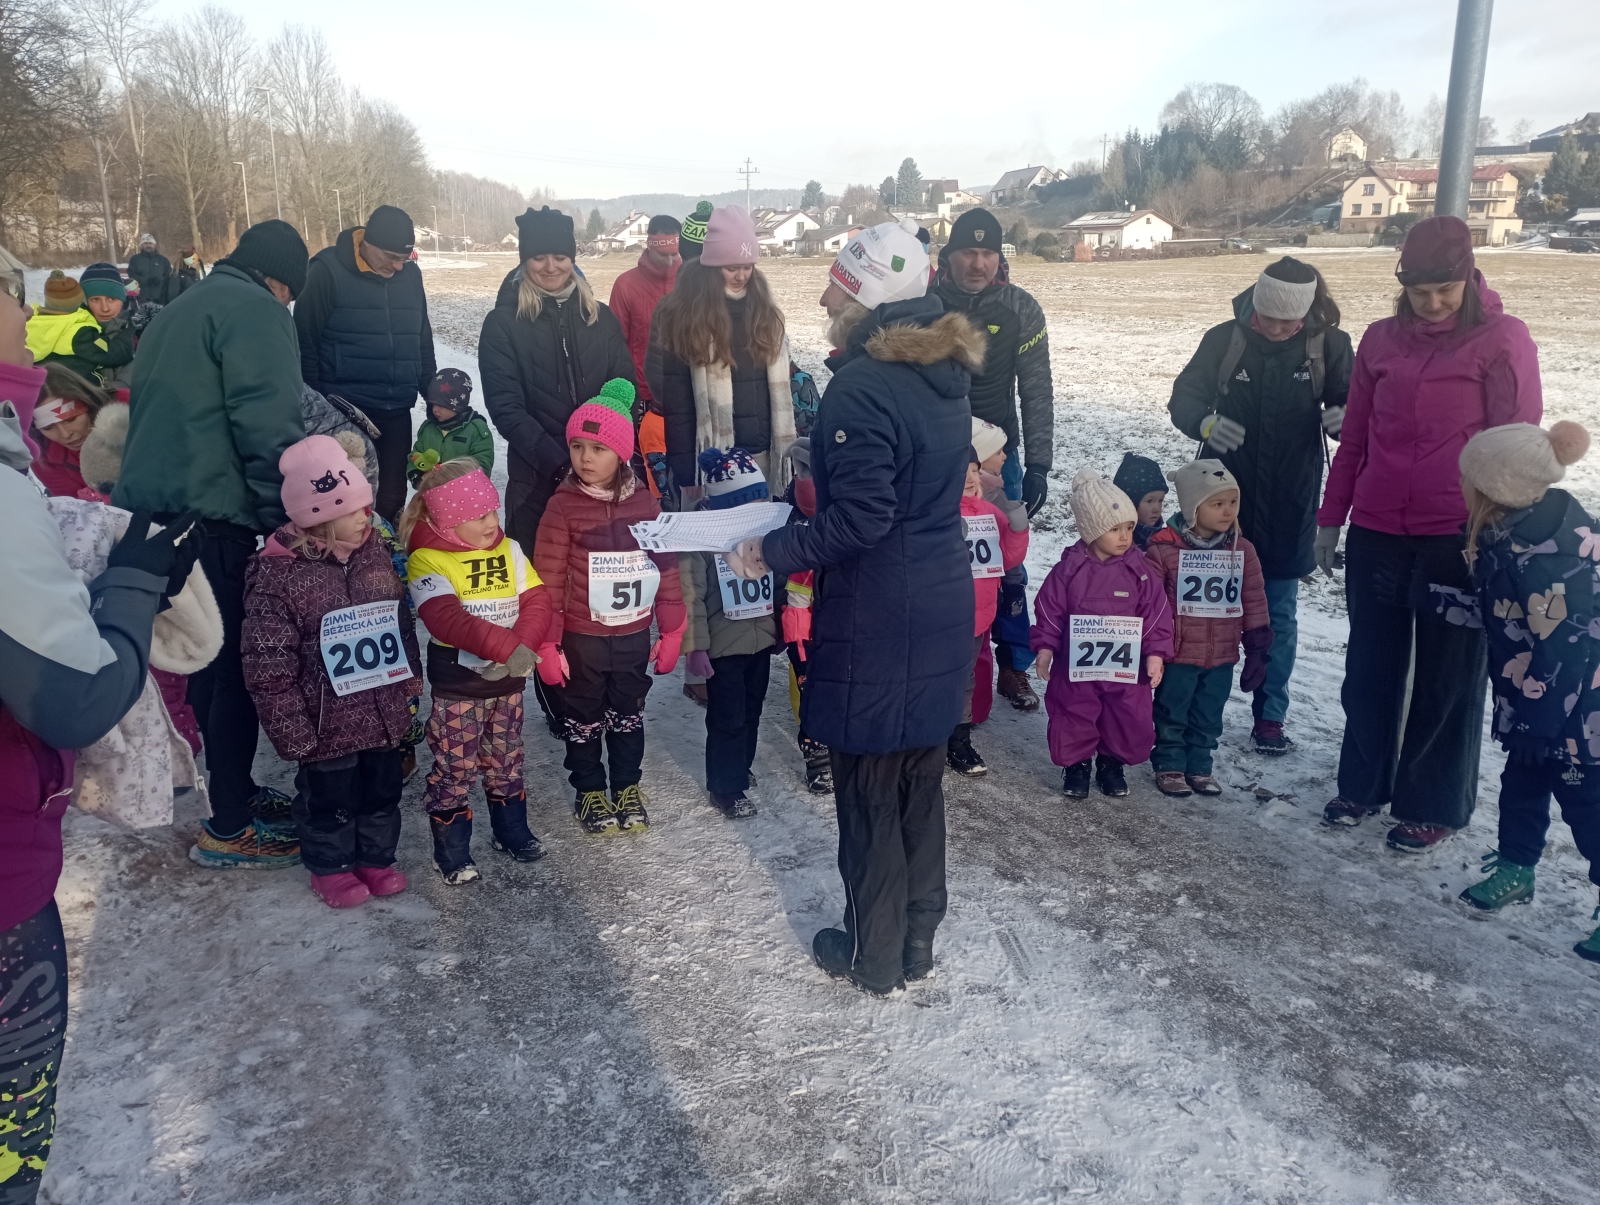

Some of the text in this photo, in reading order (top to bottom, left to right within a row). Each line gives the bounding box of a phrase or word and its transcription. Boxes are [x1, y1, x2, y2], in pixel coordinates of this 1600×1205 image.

[849, 242, 866, 260] LES
[592, 555, 625, 565] ZIMNÍ
[1182, 552, 1213, 561] ZIMNÍ
[637, 563, 656, 571] LIGA
[462, 586, 492, 596] CYCLING
[611, 580, 642, 610] 51
[726, 574, 771, 606] 108
[1182, 575, 1239, 603] 266
[323, 609, 356, 628] ZIMNÍ
[323, 615, 395, 637] BĚŽECKÁ LIGA
[1073, 617, 1104, 627] ZIMNÍ
[1073, 627, 1116, 635] BĚŽECKÁ
[328, 632, 399, 678] 209
[1076, 641, 1133, 668] 274
[201, 836, 229, 853] HOKA
